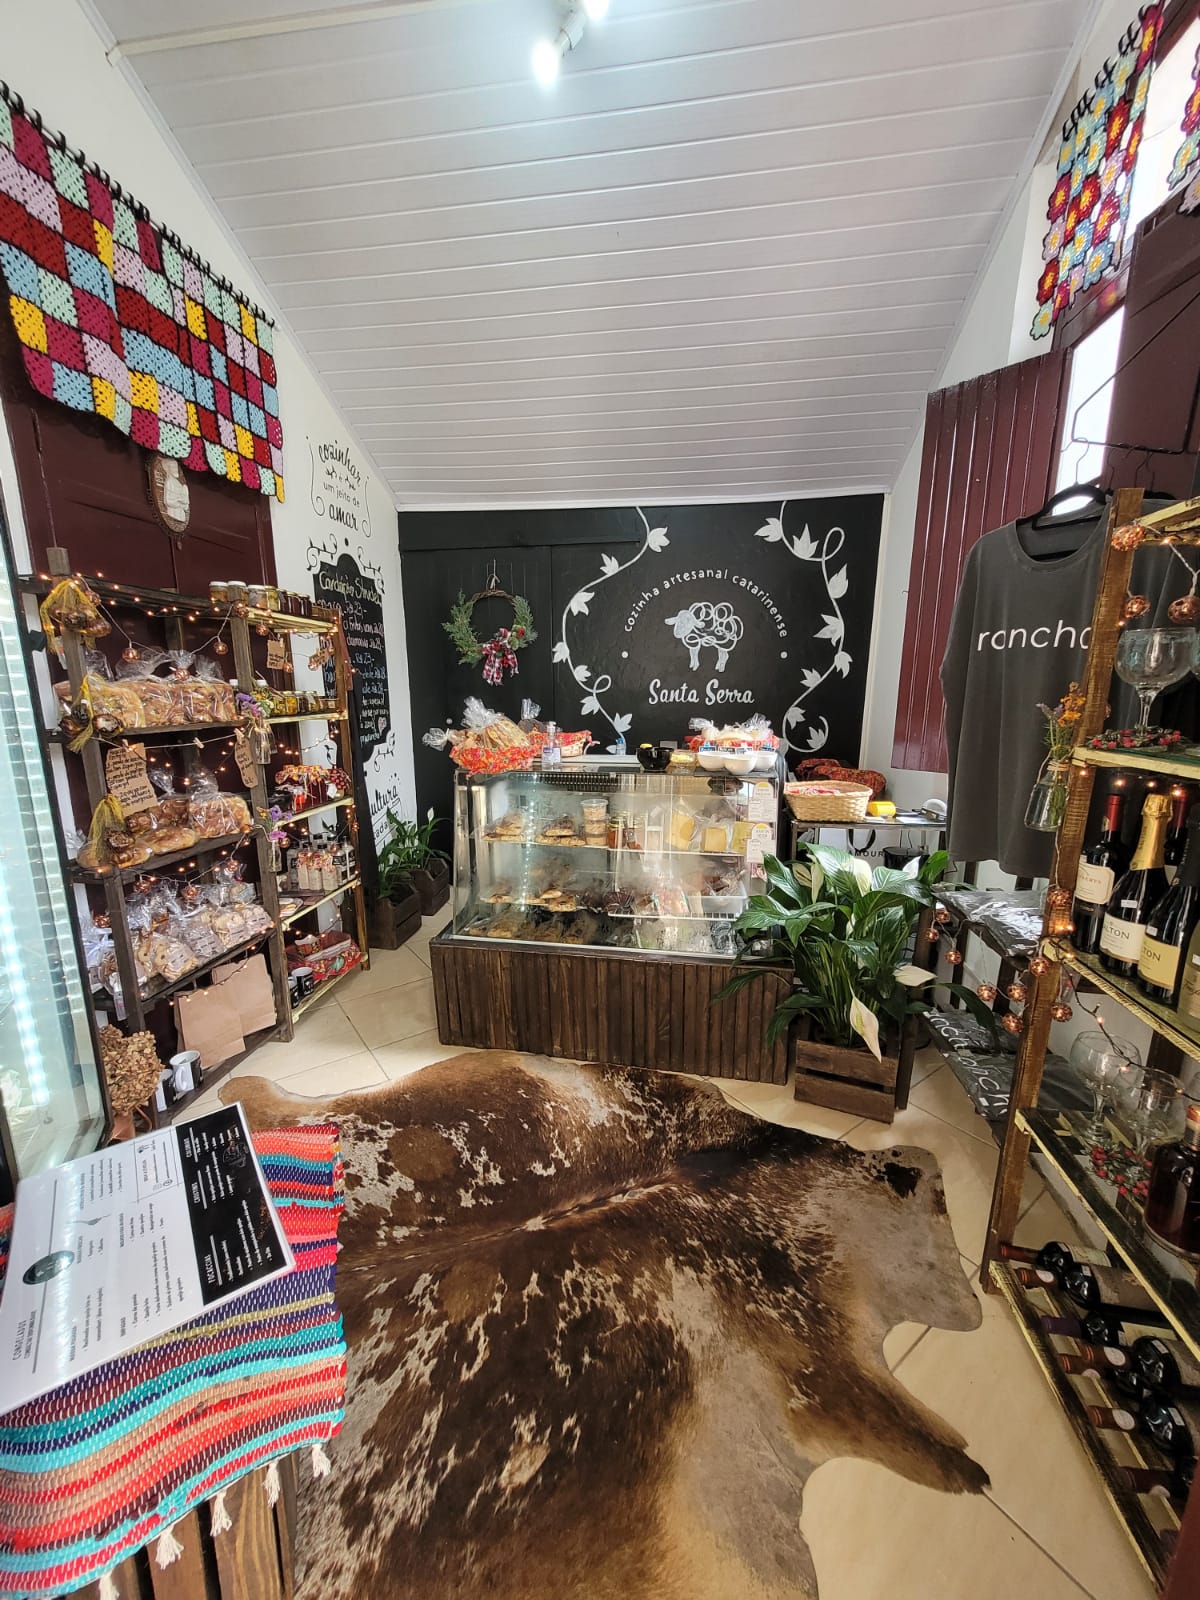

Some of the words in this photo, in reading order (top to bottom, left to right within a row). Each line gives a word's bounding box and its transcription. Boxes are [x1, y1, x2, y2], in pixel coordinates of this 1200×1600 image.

[329, 504, 359, 531] amar
[624, 586, 660, 632] cozinha
[663, 569, 728, 589] artesanal
[732, 574, 788, 638] catarinense
[648, 678, 699, 705] Santa
[705, 678, 754, 705] Serra
[371, 785, 398, 816] ultura
